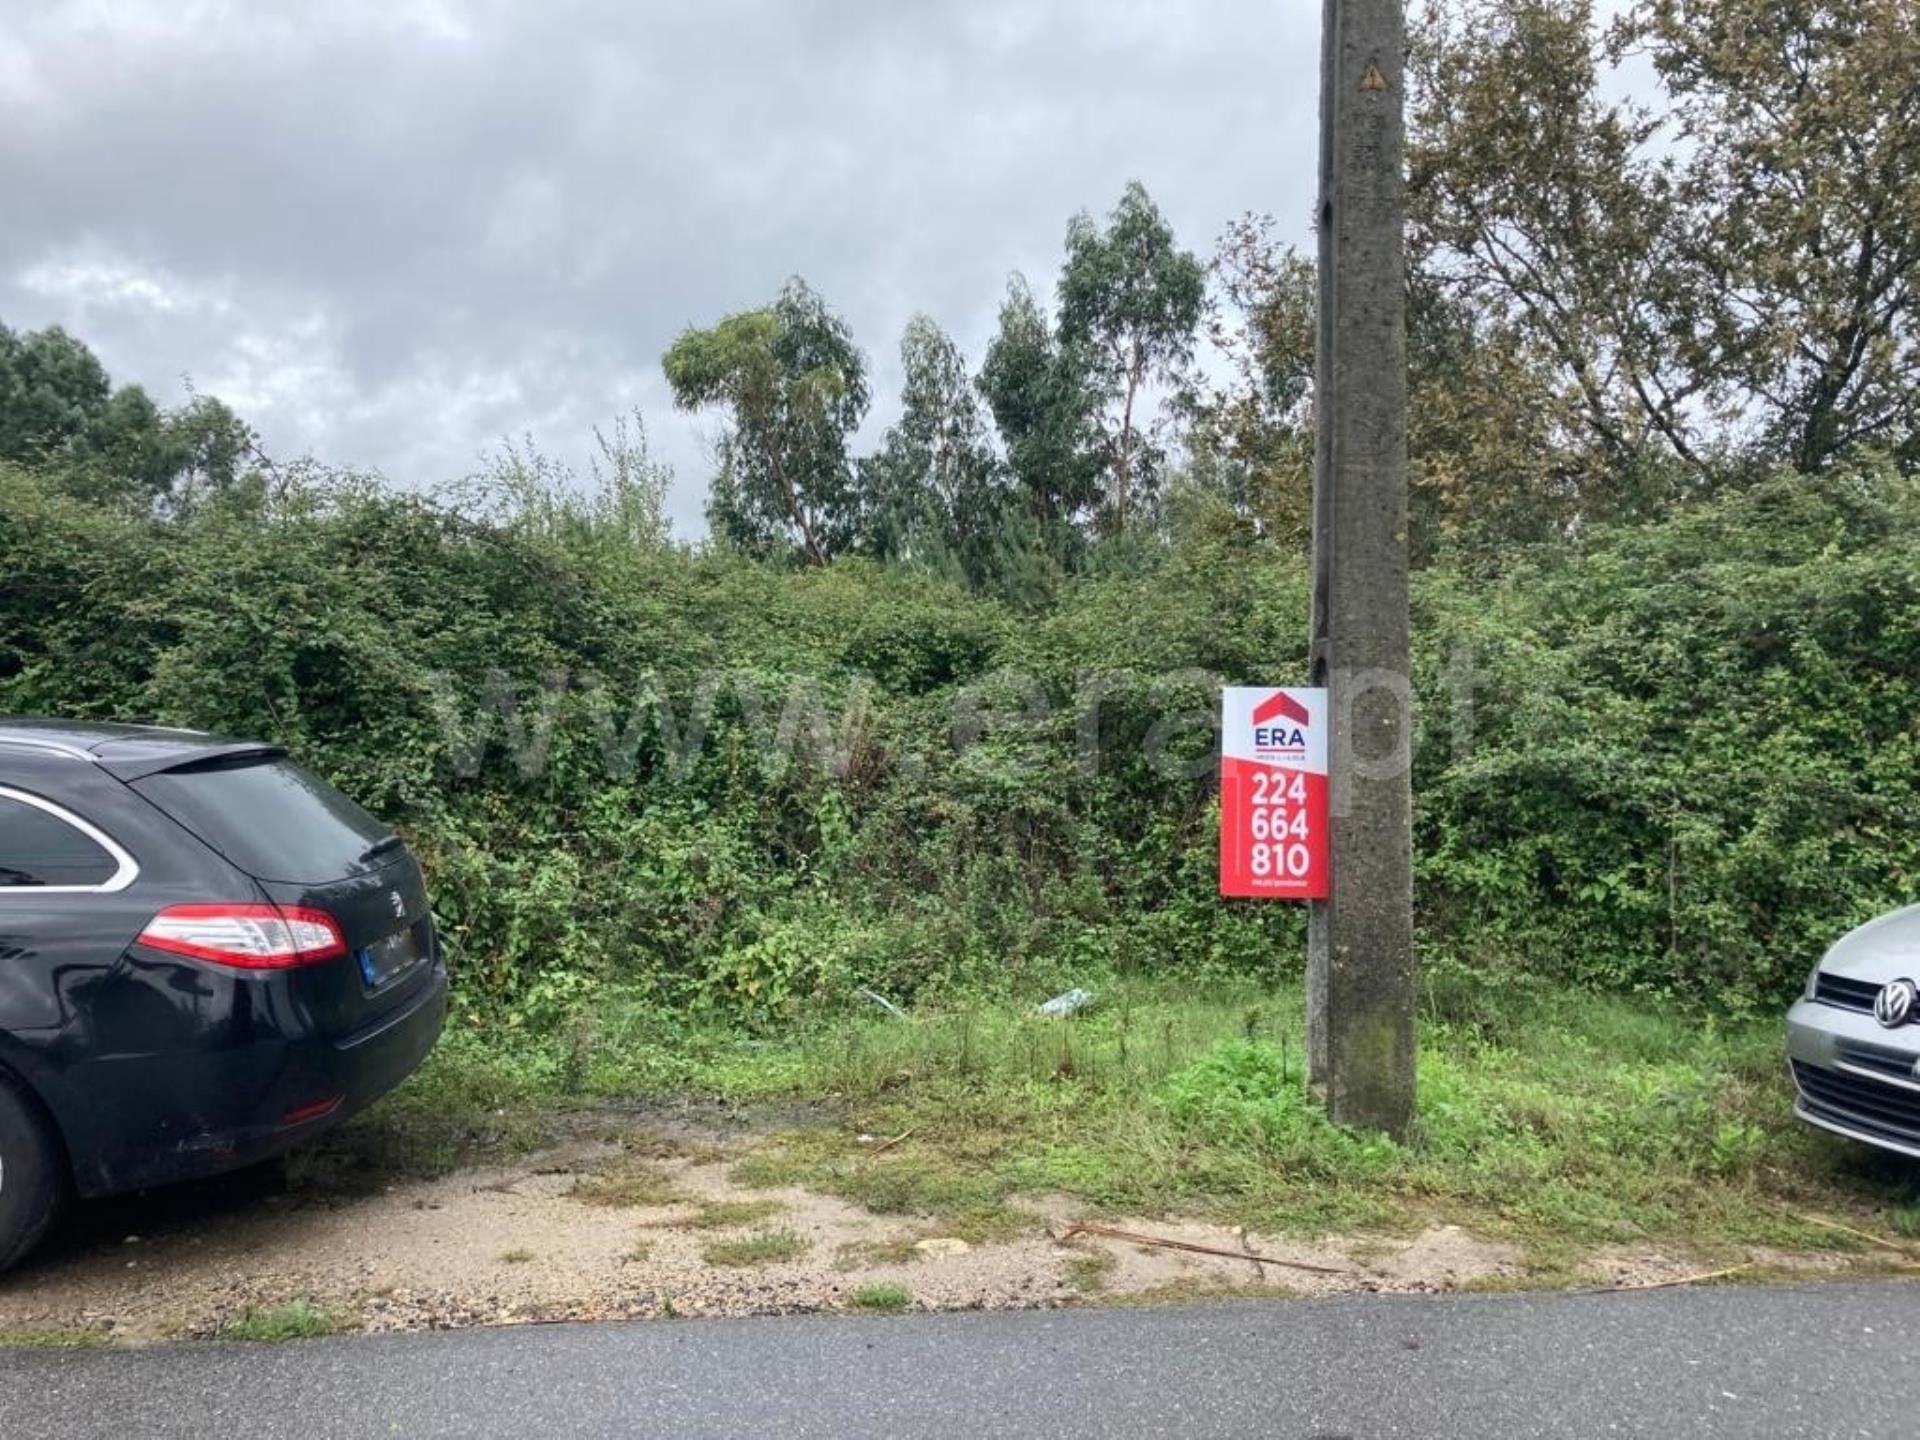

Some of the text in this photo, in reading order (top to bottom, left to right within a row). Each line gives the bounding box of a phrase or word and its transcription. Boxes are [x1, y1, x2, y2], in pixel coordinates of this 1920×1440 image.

[1255, 728, 1305, 746] ERA
[1251, 772, 1307, 805] 224
[1251, 808, 1309, 841] 664
[1251, 843, 1310, 877] 810
